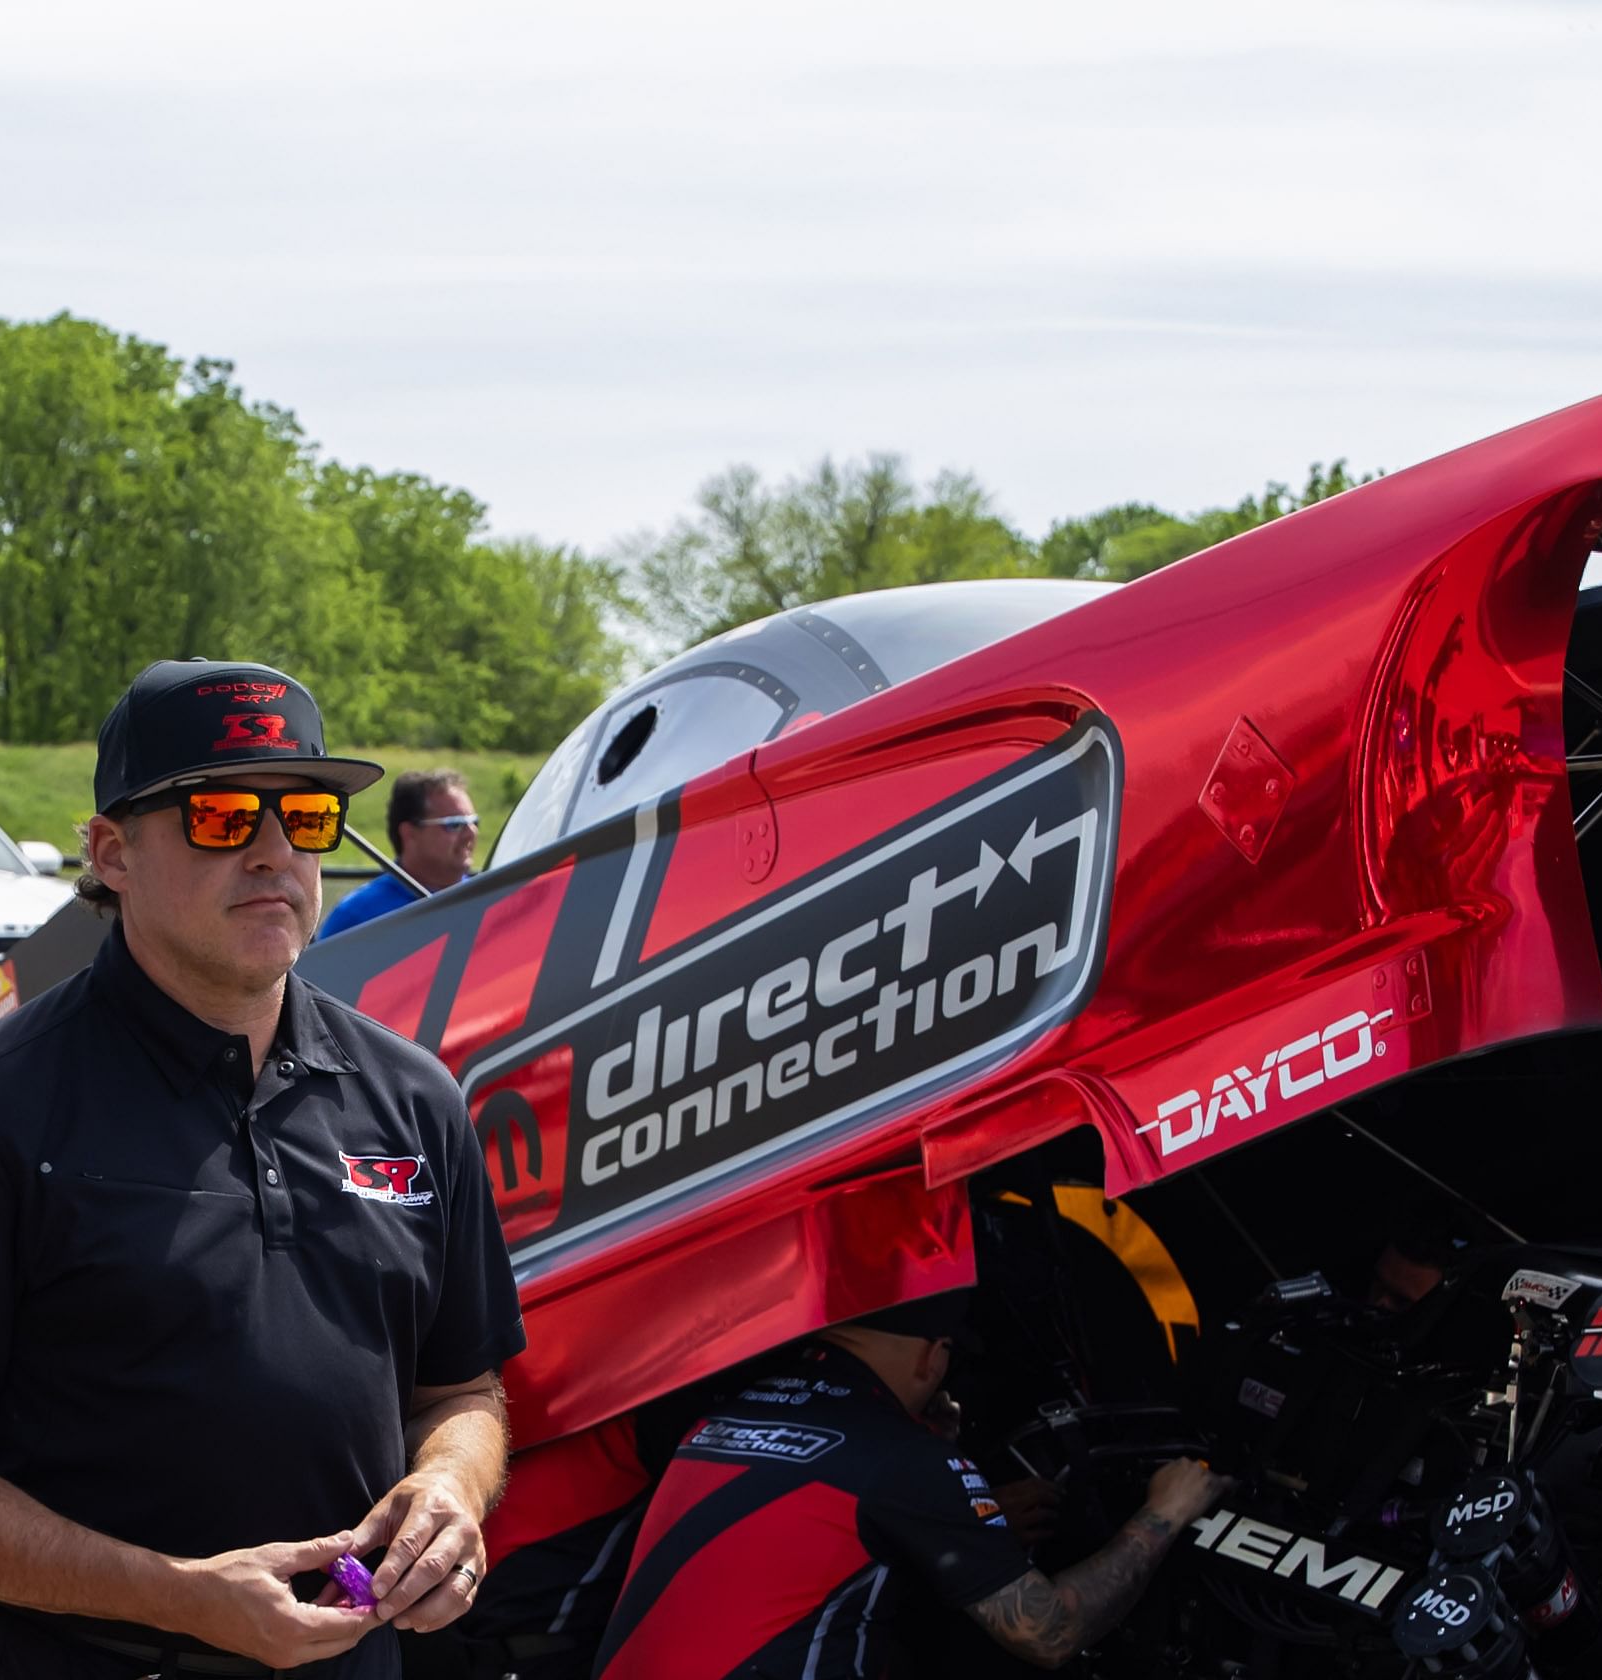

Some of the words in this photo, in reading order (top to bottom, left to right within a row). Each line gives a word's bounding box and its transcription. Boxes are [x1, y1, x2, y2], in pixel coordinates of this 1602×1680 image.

[232, 694, 276, 704] SRT
[585, 862, 938, 1121] direct
[581, 923, 1062, 1187] connection
[1156, 1009, 1374, 1157] DAYCO
[1190, 1508, 1406, 1610] HEMI
[1446, 1491, 1515, 1527] MSD
[1412, 1588, 1471, 1627] MSD
